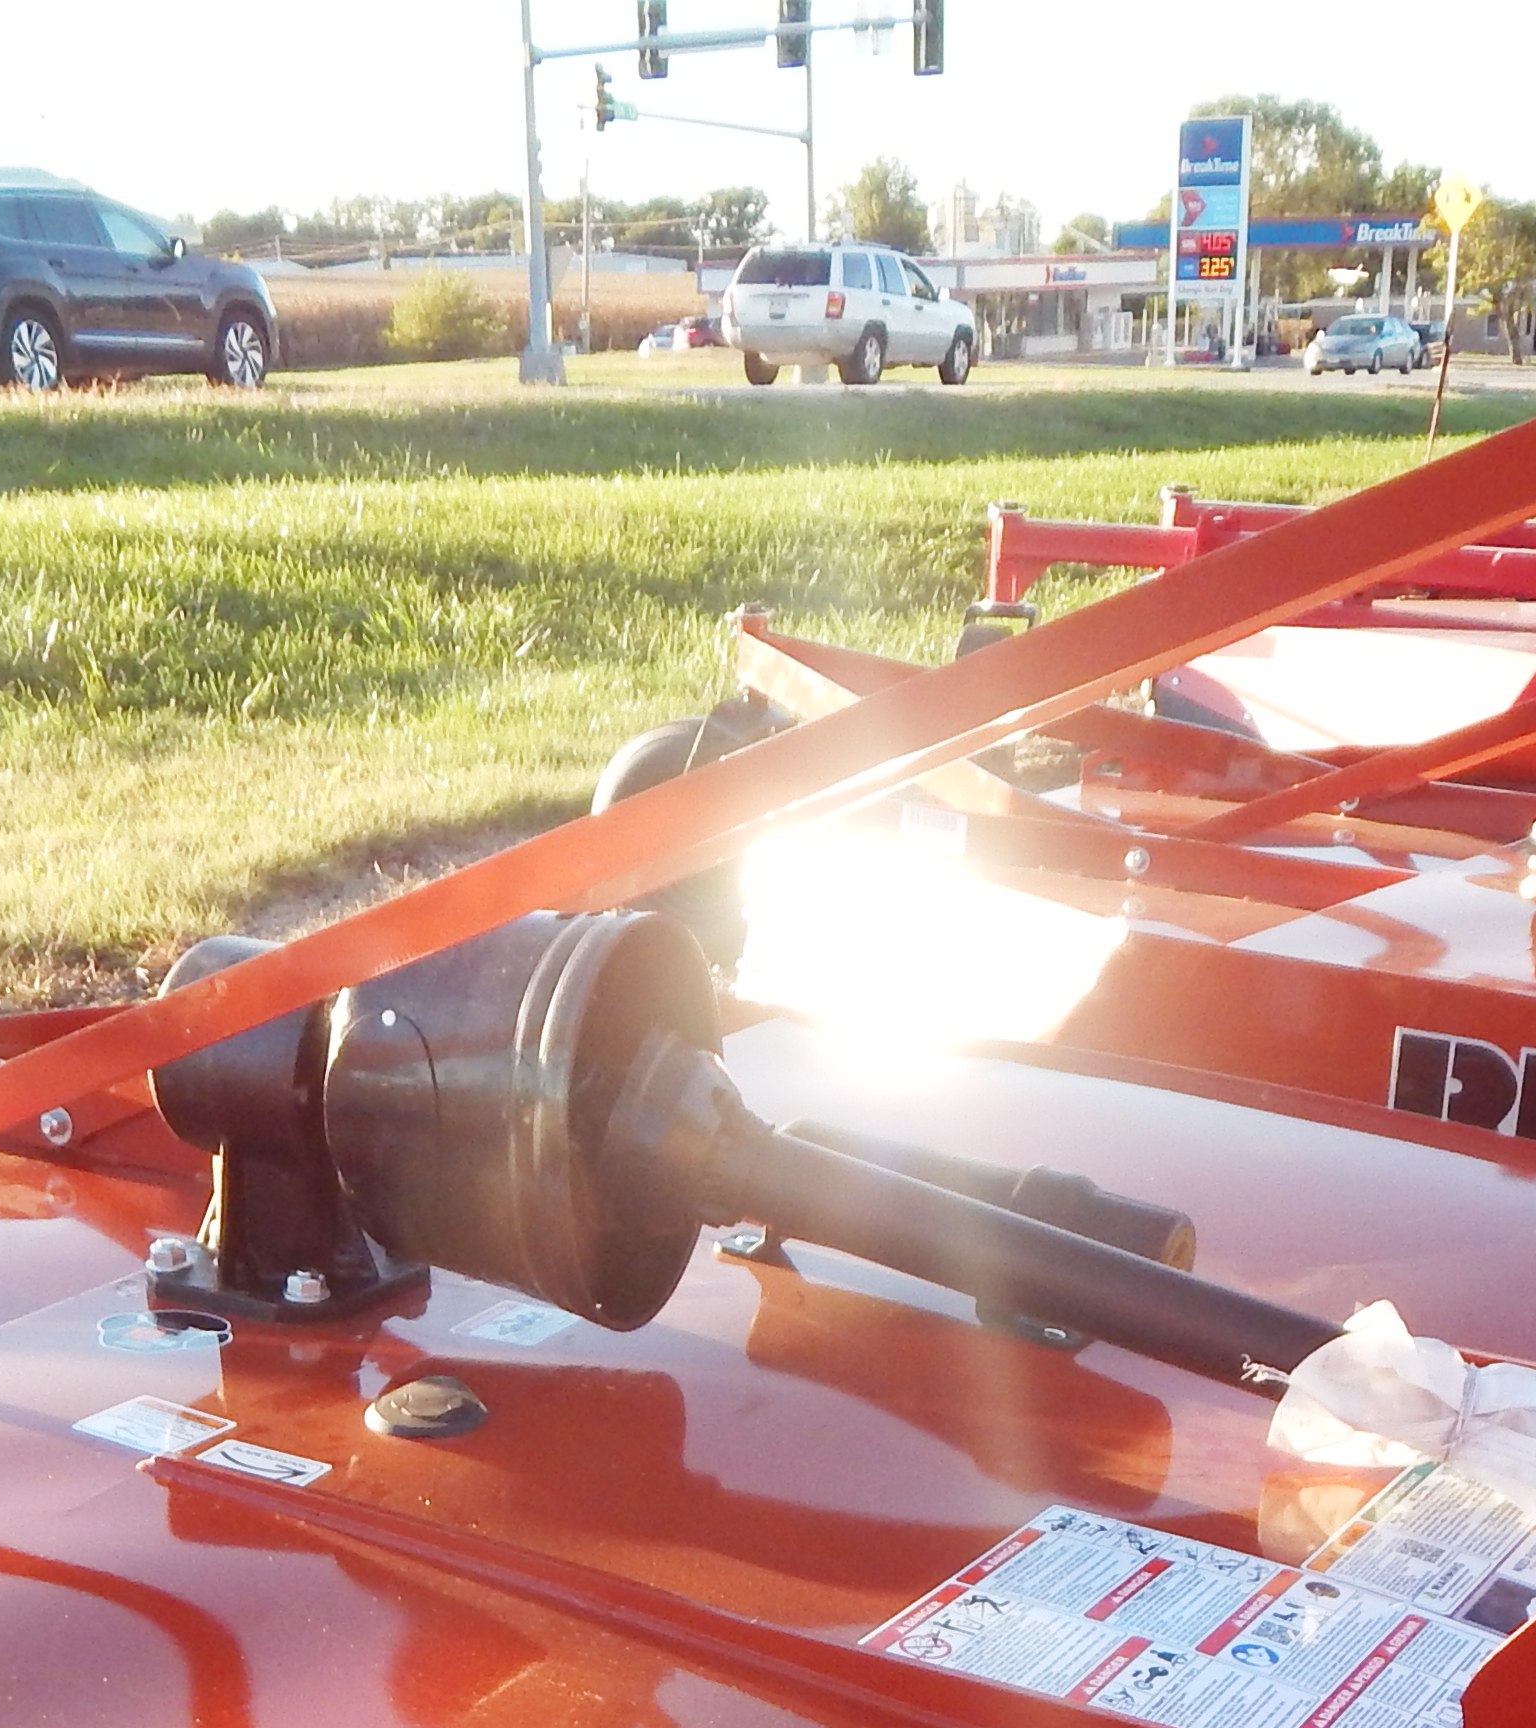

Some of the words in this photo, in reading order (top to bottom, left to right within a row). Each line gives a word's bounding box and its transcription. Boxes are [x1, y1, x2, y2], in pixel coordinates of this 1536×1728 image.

[983, 1540, 1025, 1567] DANGER
[1116, 1571, 1154, 1598] DANGER
[901, 1600, 943, 1628] DANGER
[1238, 1593, 1274, 1620] DANGER
[1088, 1655, 1130, 1688] DANGER
[1318, 1688, 1355, 1721] DANGER
